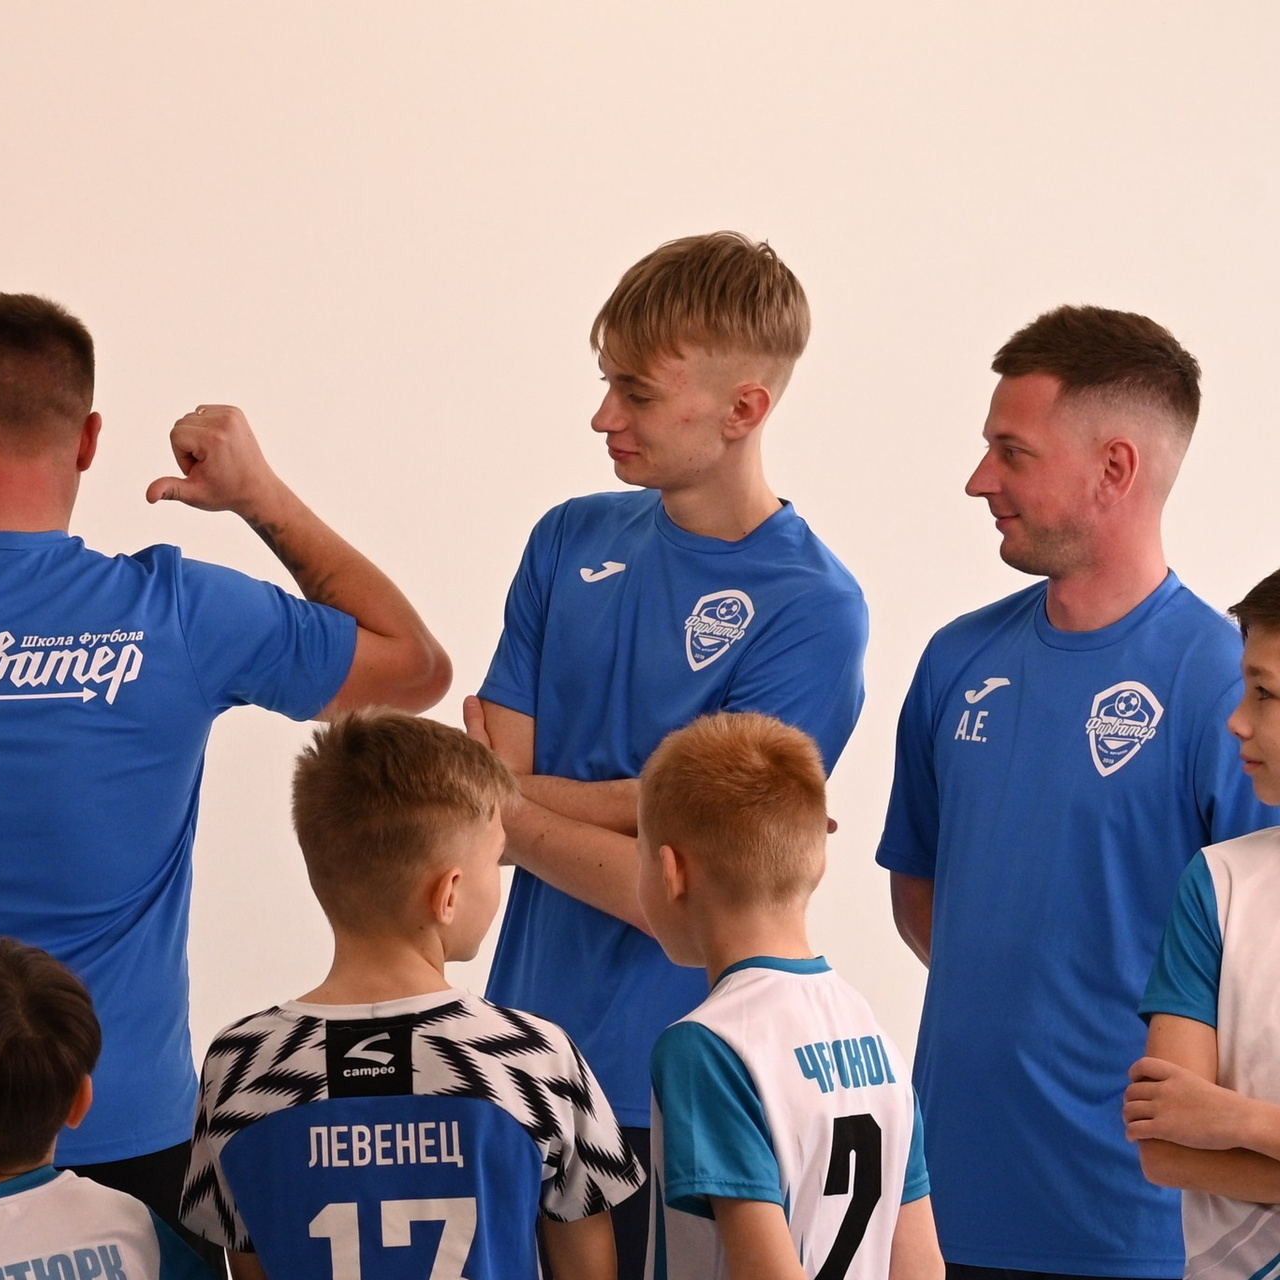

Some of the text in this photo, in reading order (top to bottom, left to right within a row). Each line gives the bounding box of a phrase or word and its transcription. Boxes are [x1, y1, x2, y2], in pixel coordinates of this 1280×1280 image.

[20, 629, 144, 648] Школа Футбола
[1085, 718, 1156, 745] Фарватер
[343, 1066, 395, 1078] campeo
[308, 1121, 464, 1168] ЛЕВЕНЕЦ
